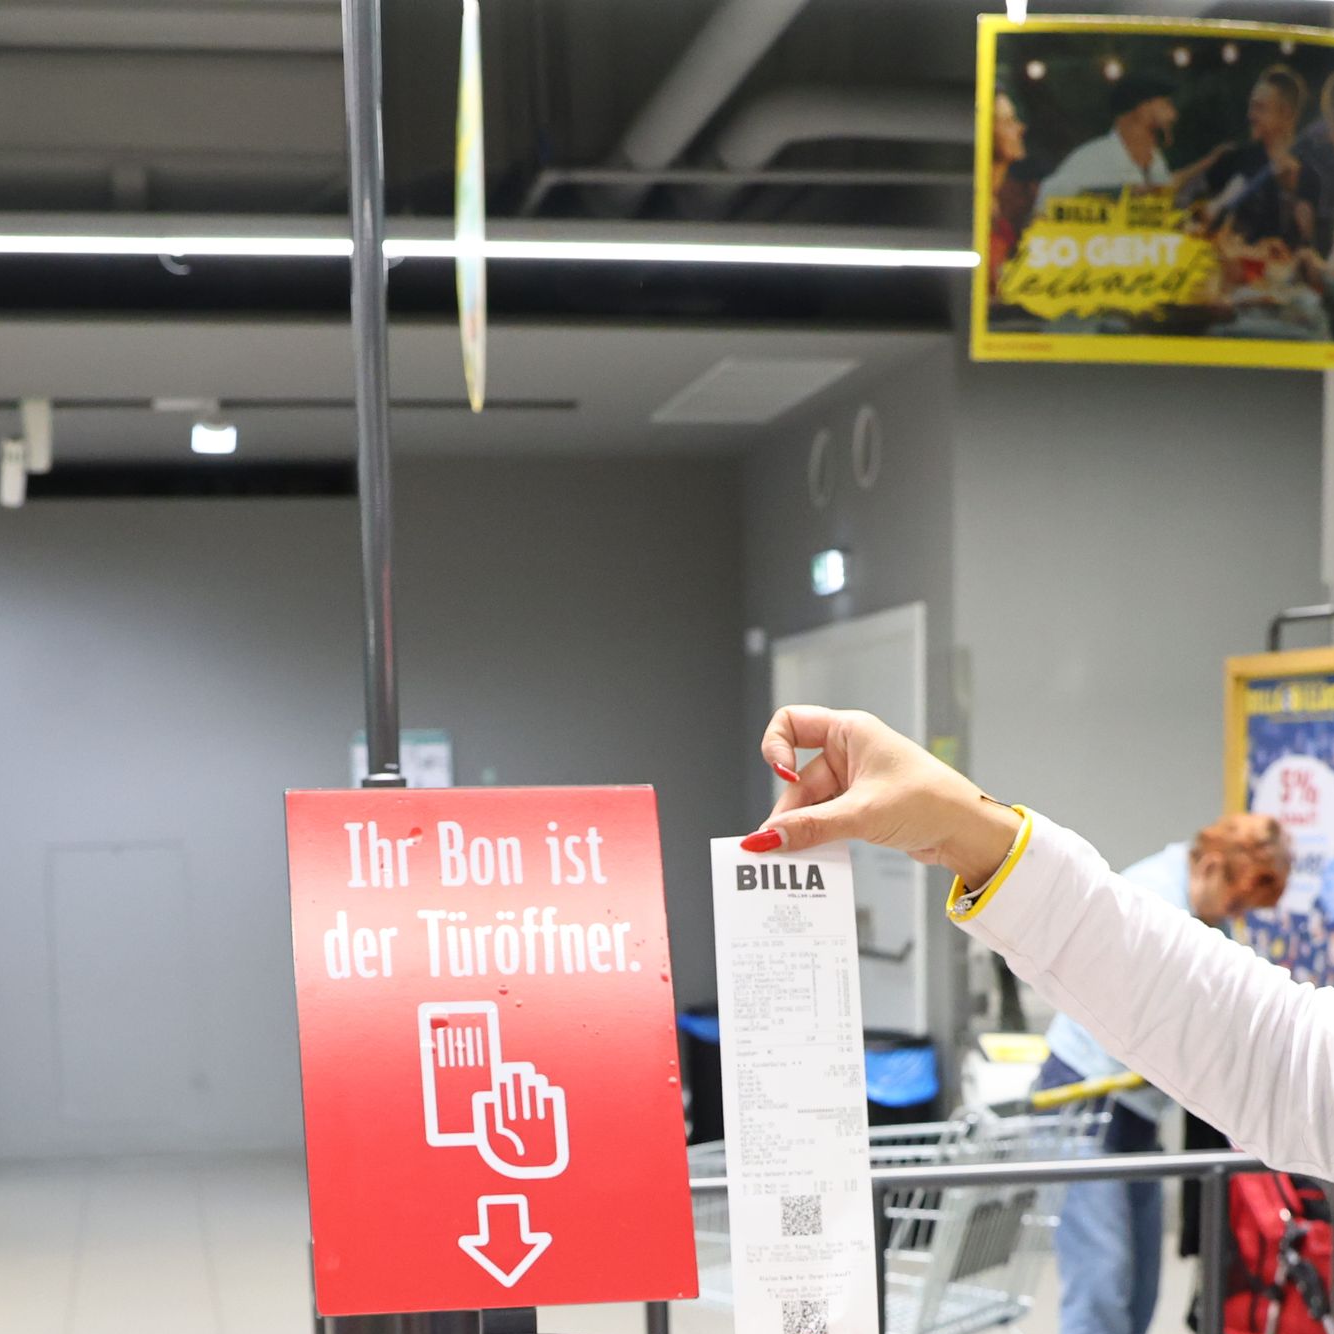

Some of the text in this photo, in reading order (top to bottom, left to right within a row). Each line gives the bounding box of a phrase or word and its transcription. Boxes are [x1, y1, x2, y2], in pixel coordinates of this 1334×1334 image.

[1028, 234, 1184, 268] SO GEHT
[344, 819, 608, 889] Ihr Bon ist
[736, 864, 826, 891] BILLA
[323, 906, 641, 979] der Türöffner.
